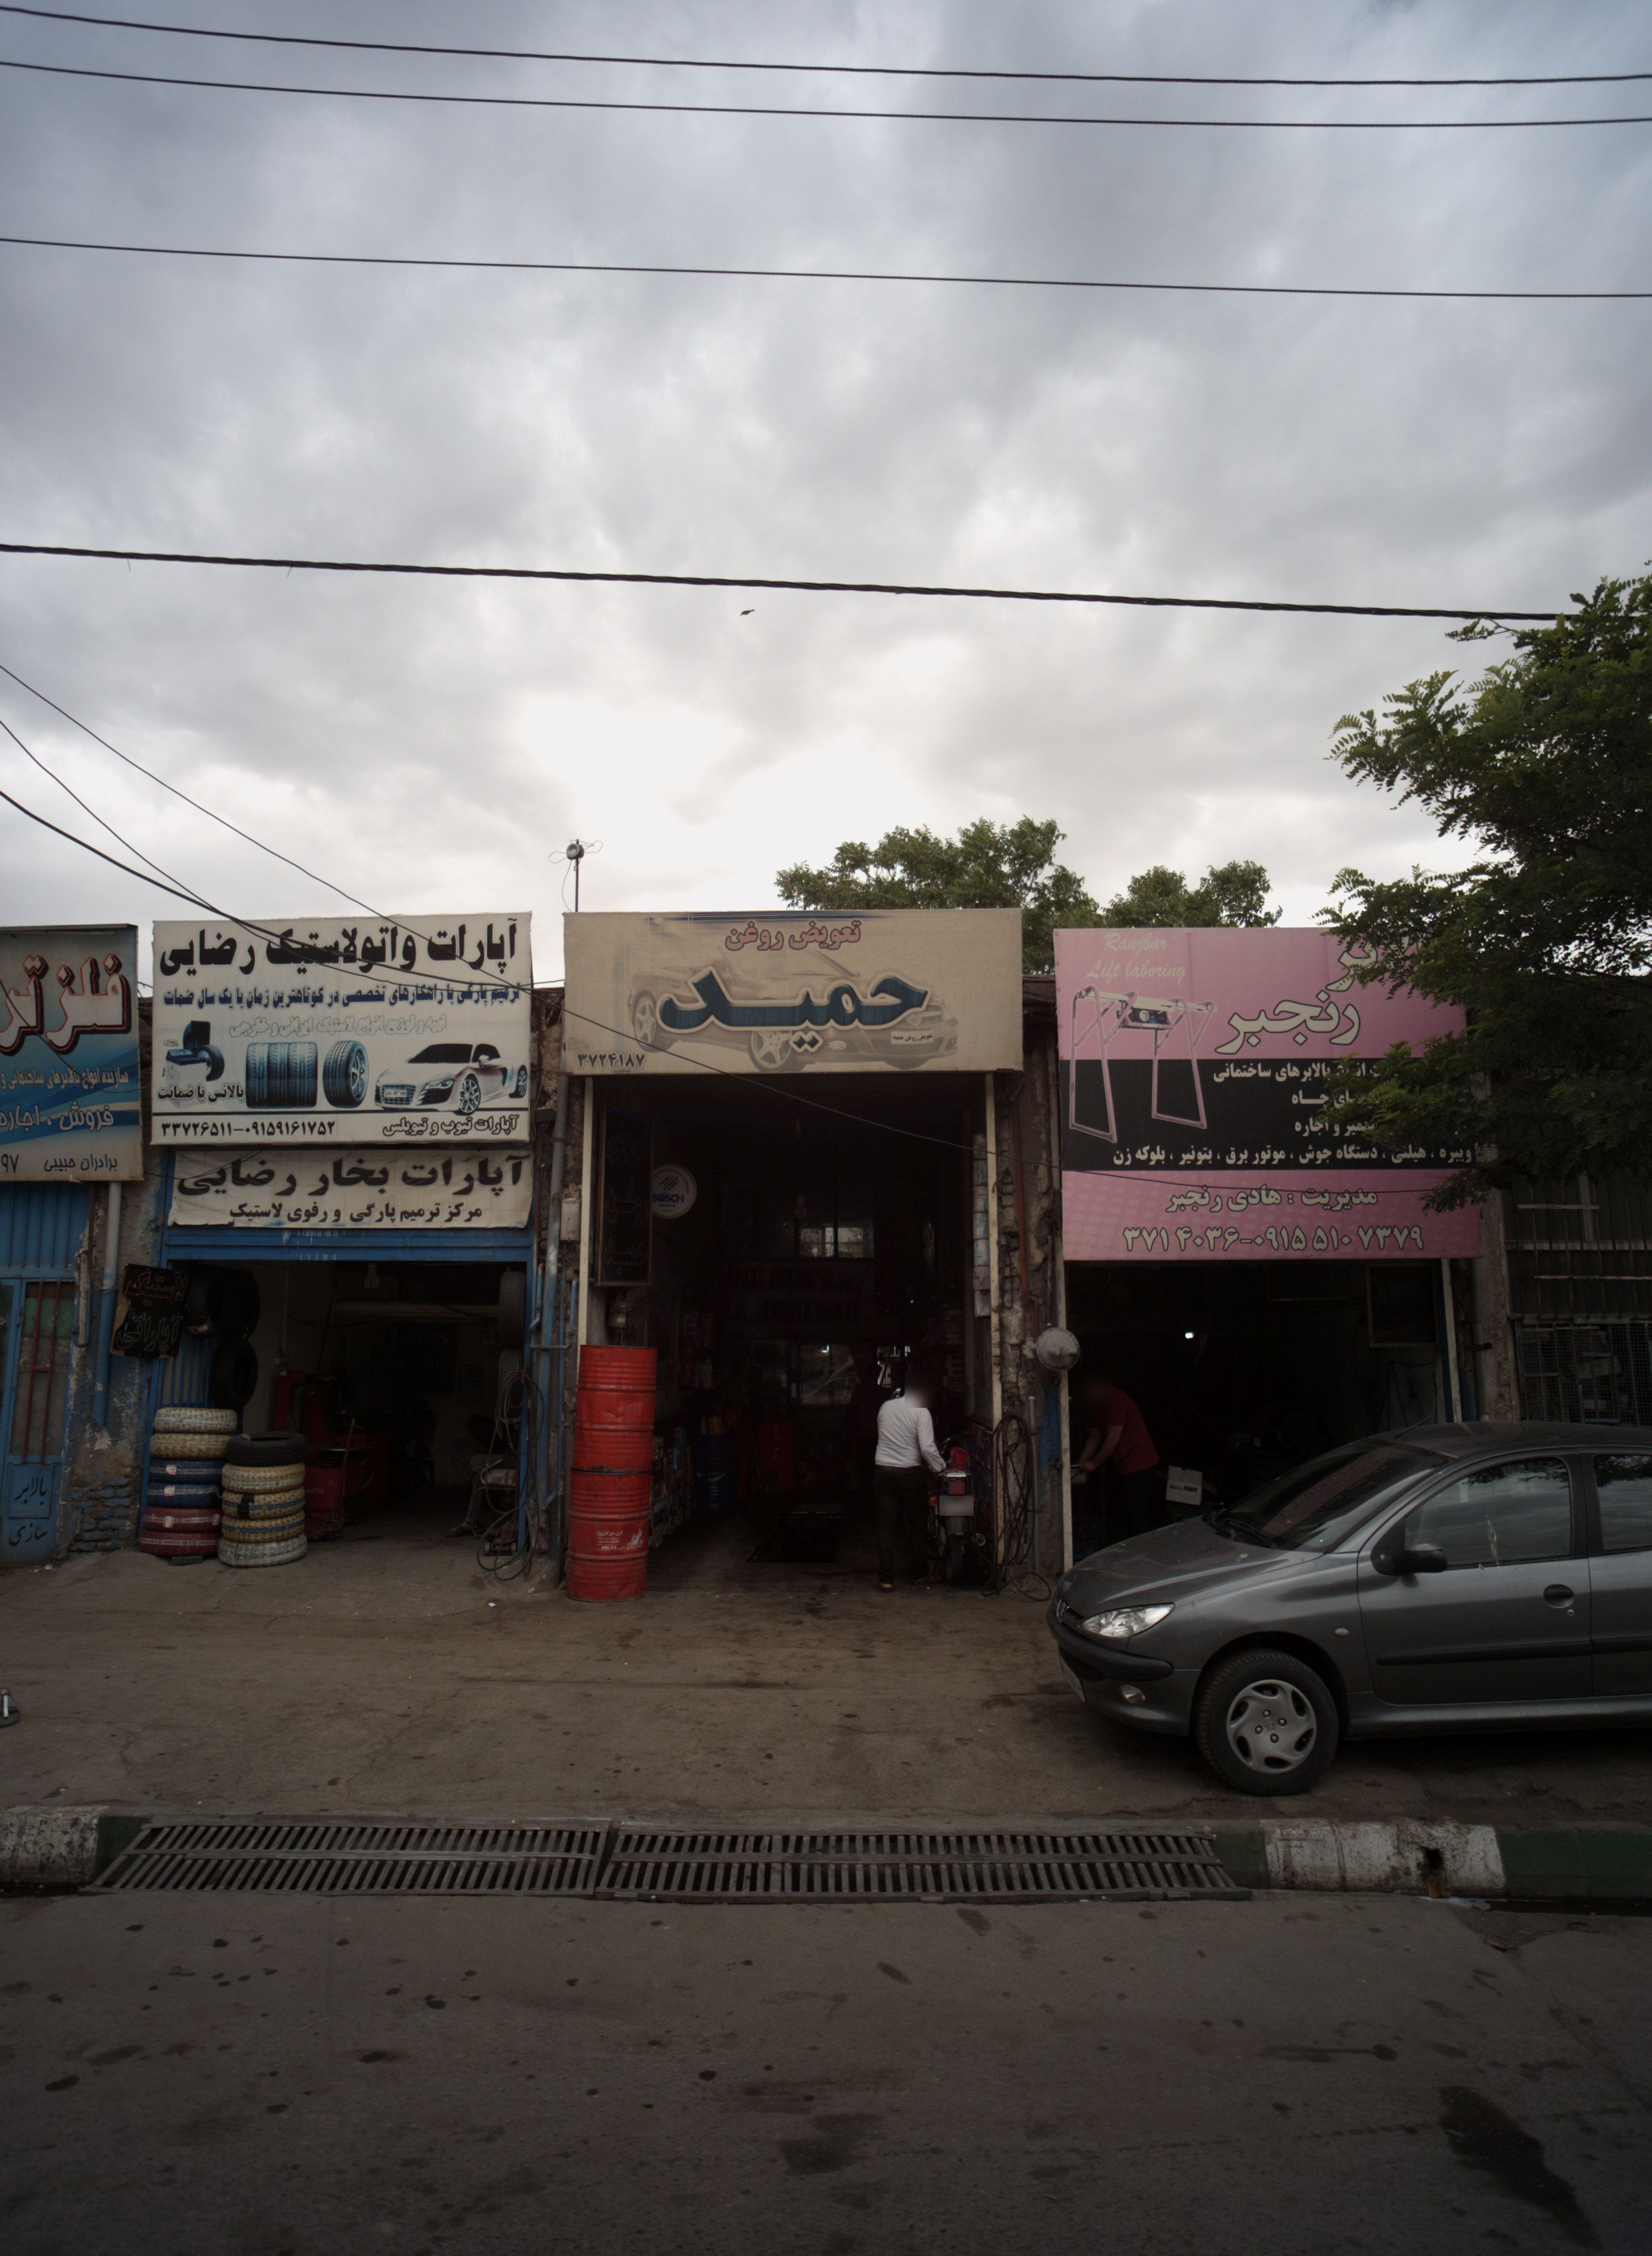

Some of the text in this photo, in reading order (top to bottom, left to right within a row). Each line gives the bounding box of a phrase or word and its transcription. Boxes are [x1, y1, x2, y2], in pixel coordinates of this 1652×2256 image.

[427, 918, 518, 974] آپارات
[725, 920, 862, 951] تعویض روغن
[1104, 932, 1167, 956] Ranjbar
[160, 929, 256, 976] رضایی
[1086, 958, 1186, 984] Lift laboring
[45, 953, 132, 1055] فلز
[198, 988, 215, 1009] سال
[219, 988, 232, 1008] یک
[237, 988, 243, 1008] با
[247, 988, 269, 1008] زمان
[328, 990, 339, 1007] در
[343, 985, 386, 1007] تخصصی
[389, 983, 443, 1006] راهکارهای
[447, 983, 454, 1005] با
[457, 981, 486, 1006] پارگی
[492, 982, 520, 1006] ترمیم
[656, 967, 932, 1053] حمید
[229, 1017, 270, 1038] خارجی
[269, 1022, 279, 1038] و
[279, 1016, 314, 1037] ایرانی
[316, 1015, 355, 1036] لاستیک
[356, 1015, 385, 1036] انواع
[416, 1020, 425, 1034] و
[1215, 990, 1360, 1054] رنجبر
[577, 1048, 645, 1068] ۳۷۲۴۱۸۷
[8, 1067, 45, 1090] ساختمانی
[82, 1066, 100, 1089] انواع
[102, 1066, 129, 1089] سازنده
[1213, 1062, 1272, 1083] ساختمانی
[1275, 1062, 1330, 1082] بالابرهای
[158, 1083, 244, 1103] بالانس با ضمانت
[0, 1104, 41, 1132] اجاره
[59, 1100, 115, 1132] فروش
[383, 1114, 520, 1137] آپارات تیوب و تیوبلس
[1294, 1116, 1329, 1137] اجاره
[1333, 1124, 1340, 1137] و
[1113, 1148, 1132, 1165] زن
[1135, 1145, 1166, 1165] بلوکه
[1178, 1145, 1213, 1165] بتونیر
[1225, 1147, 1248, 1165] برق
[1252, 1145, 1286, 1165] موتور
[1298, 1144, 1333, 1164] جوش
[1336, 1143, 1378, 1159] دستگاه
[1439, 1147, 1472, 1164] ویبره
[44, 1154, 118, 1172] برادران حبیبی
[178, 1154, 531, 1197] آپارات بخار رضایی
[652, 1193, 684, 1203] BOSCH
[1165, 1184, 1222, 1212] رنجبر
[1227, 1183, 1282, 1212] هادی
[1301, 1187, 1378, 1212] مدیریت
[230, 1201, 482, 1223] مرکز ترمیم پارگی و رفوی لاستیک
[1122, 1227, 1169, 1251] ۳۷۱
[1357, 1225, 1424, 1250] ۷۳۷۹
[125, 1270, 189, 1306] لاستیک
[14, 1476, 47, 1506] بالابر
[9, 1522, 48, 1547] سازی
